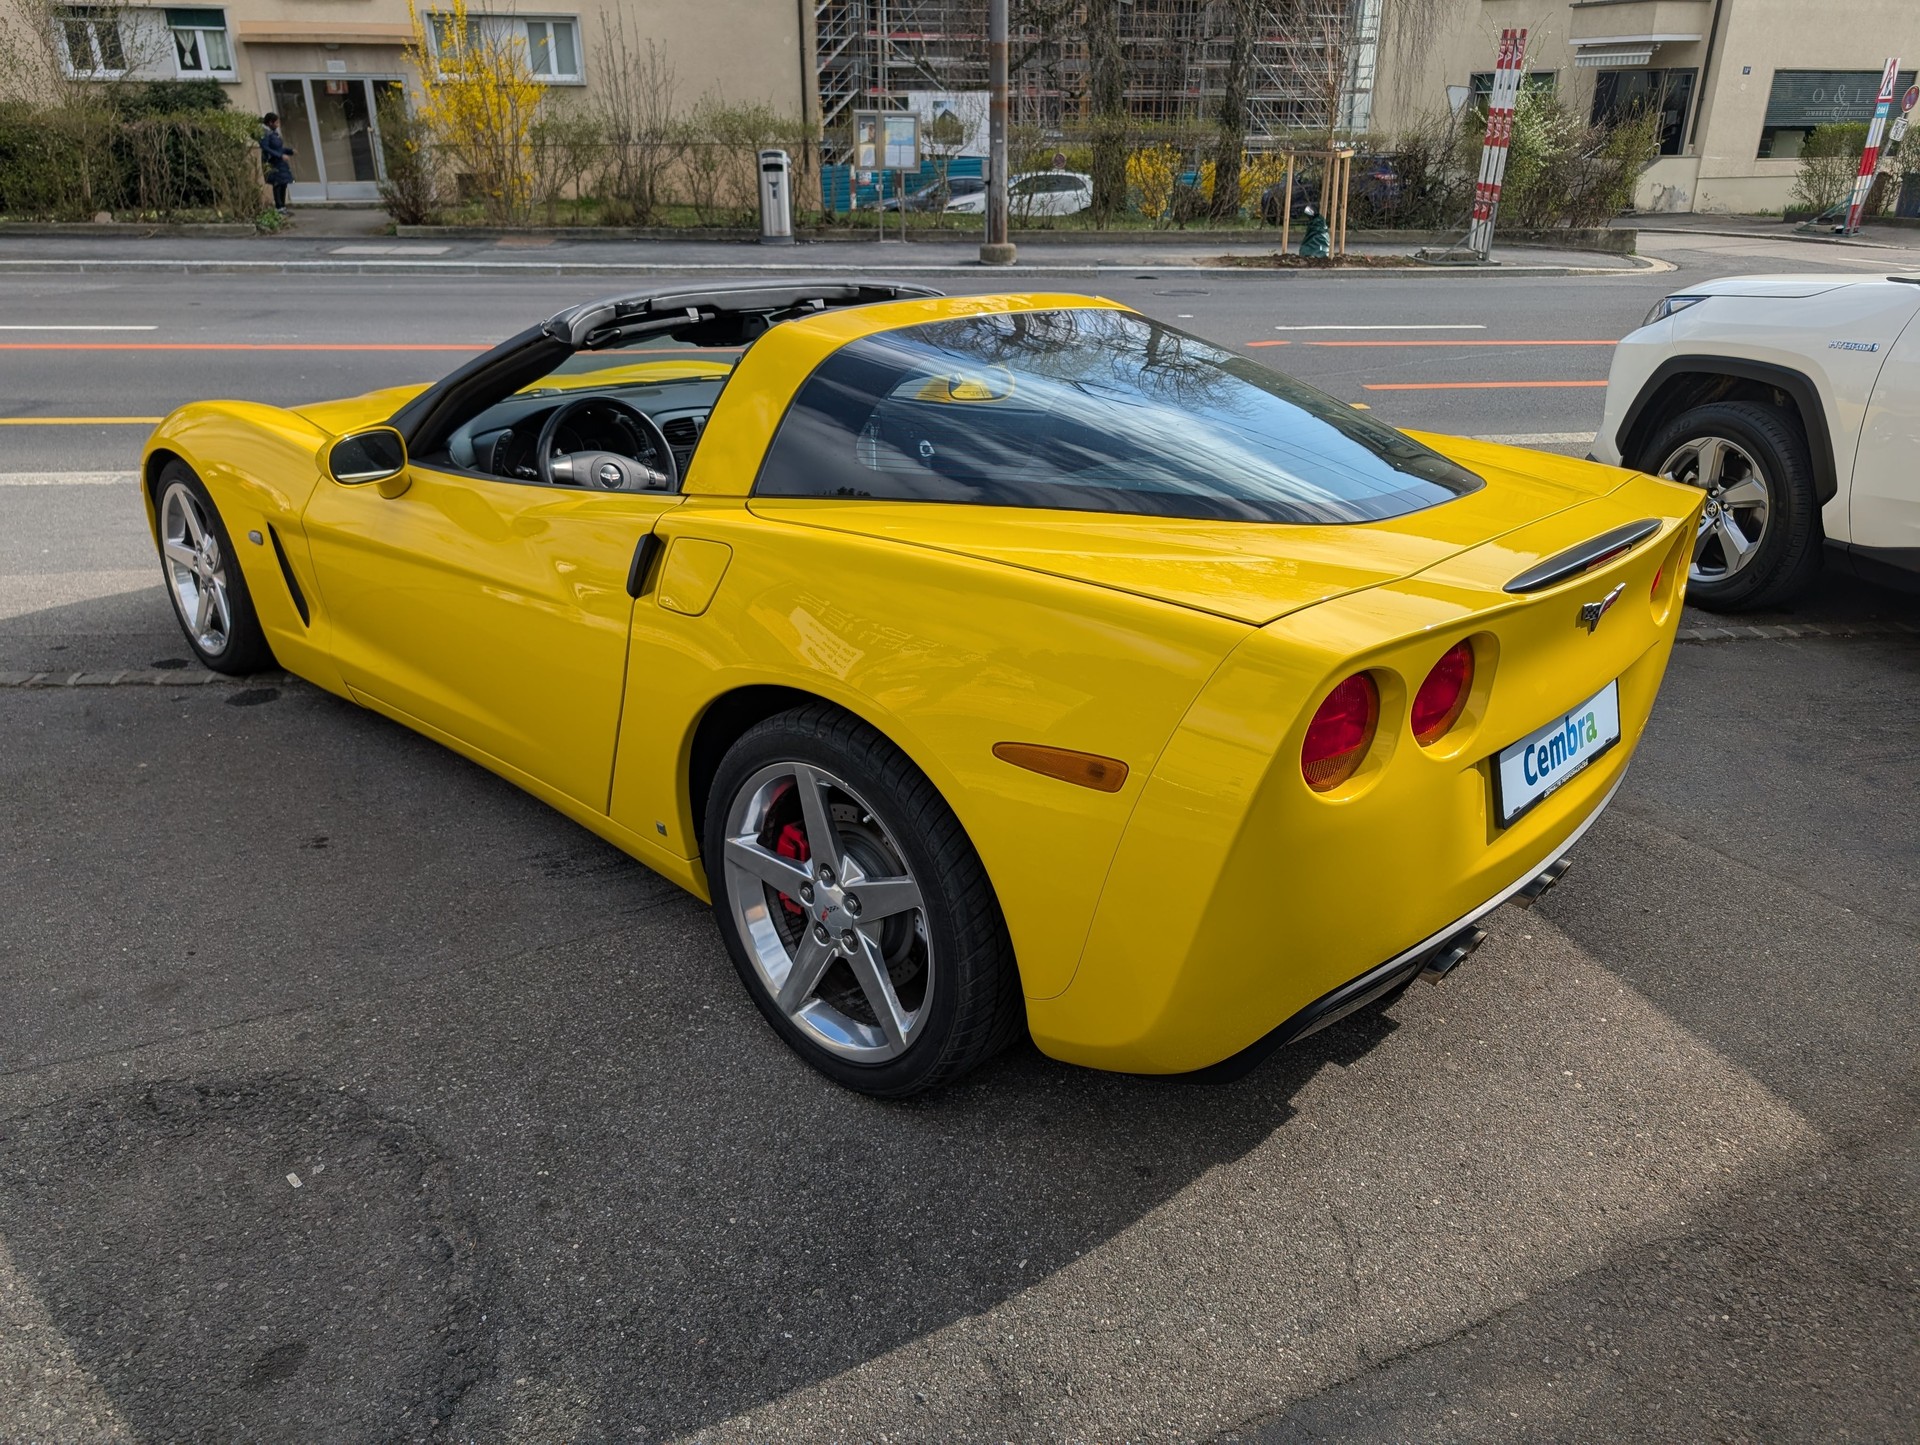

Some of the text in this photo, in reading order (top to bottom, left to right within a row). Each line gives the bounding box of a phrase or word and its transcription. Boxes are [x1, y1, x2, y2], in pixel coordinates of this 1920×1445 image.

[1812, 88, 1824, 103] O
[1833, 84, 1846, 104] &
[1828, 340, 1871, 351] HYBRID
[1523, 709, 1597, 787] Cembra
